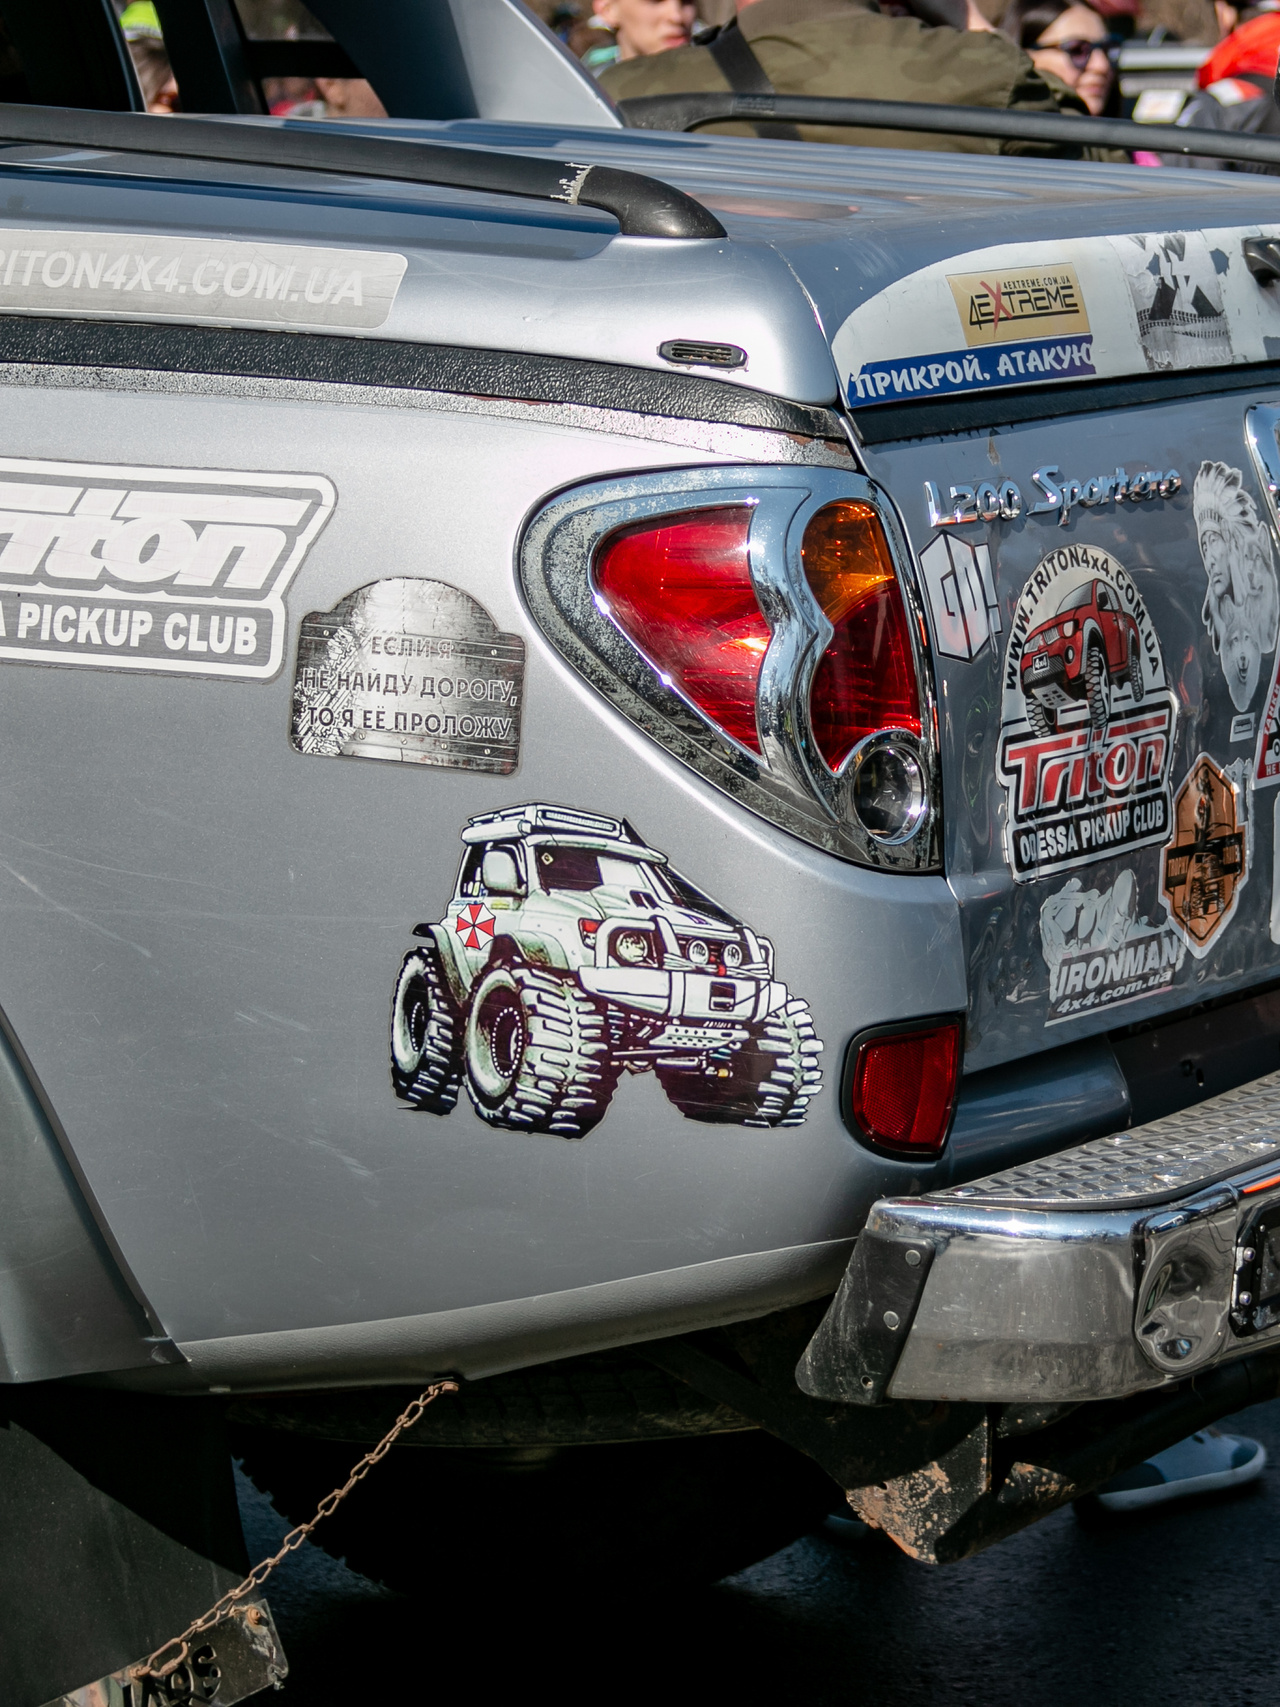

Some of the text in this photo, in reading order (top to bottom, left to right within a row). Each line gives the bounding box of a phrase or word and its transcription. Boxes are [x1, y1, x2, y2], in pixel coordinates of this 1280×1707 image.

[1003, 275, 1070, 290] 4EXTREME.COM.UA
[851, 342, 1095, 398] ПРИКРОЙ, АТАКУЮ
[923, 465, 1183, 527] L200 Sportero
[17, 602, 153, 648] PICKUP
[163, 612, 258, 656] CLUB
[371, 634, 453, 660] ЕСЛИ Я
[303, 668, 517, 706] НЕ НАЙДУ ДОРОГУ,
[394, 710, 512, 740] ПРОЛОЖУ
[1008, 709, 1167, 815] Triton
[1266, 764, 1276, 776] НЕ
[1019, 802, 1165, 865] ODESSA PICKUP CLUB
[1056, 934, 1179, 997] IRONMAN
[1057, 971, 1172, 1014] 4x4.com.ua
